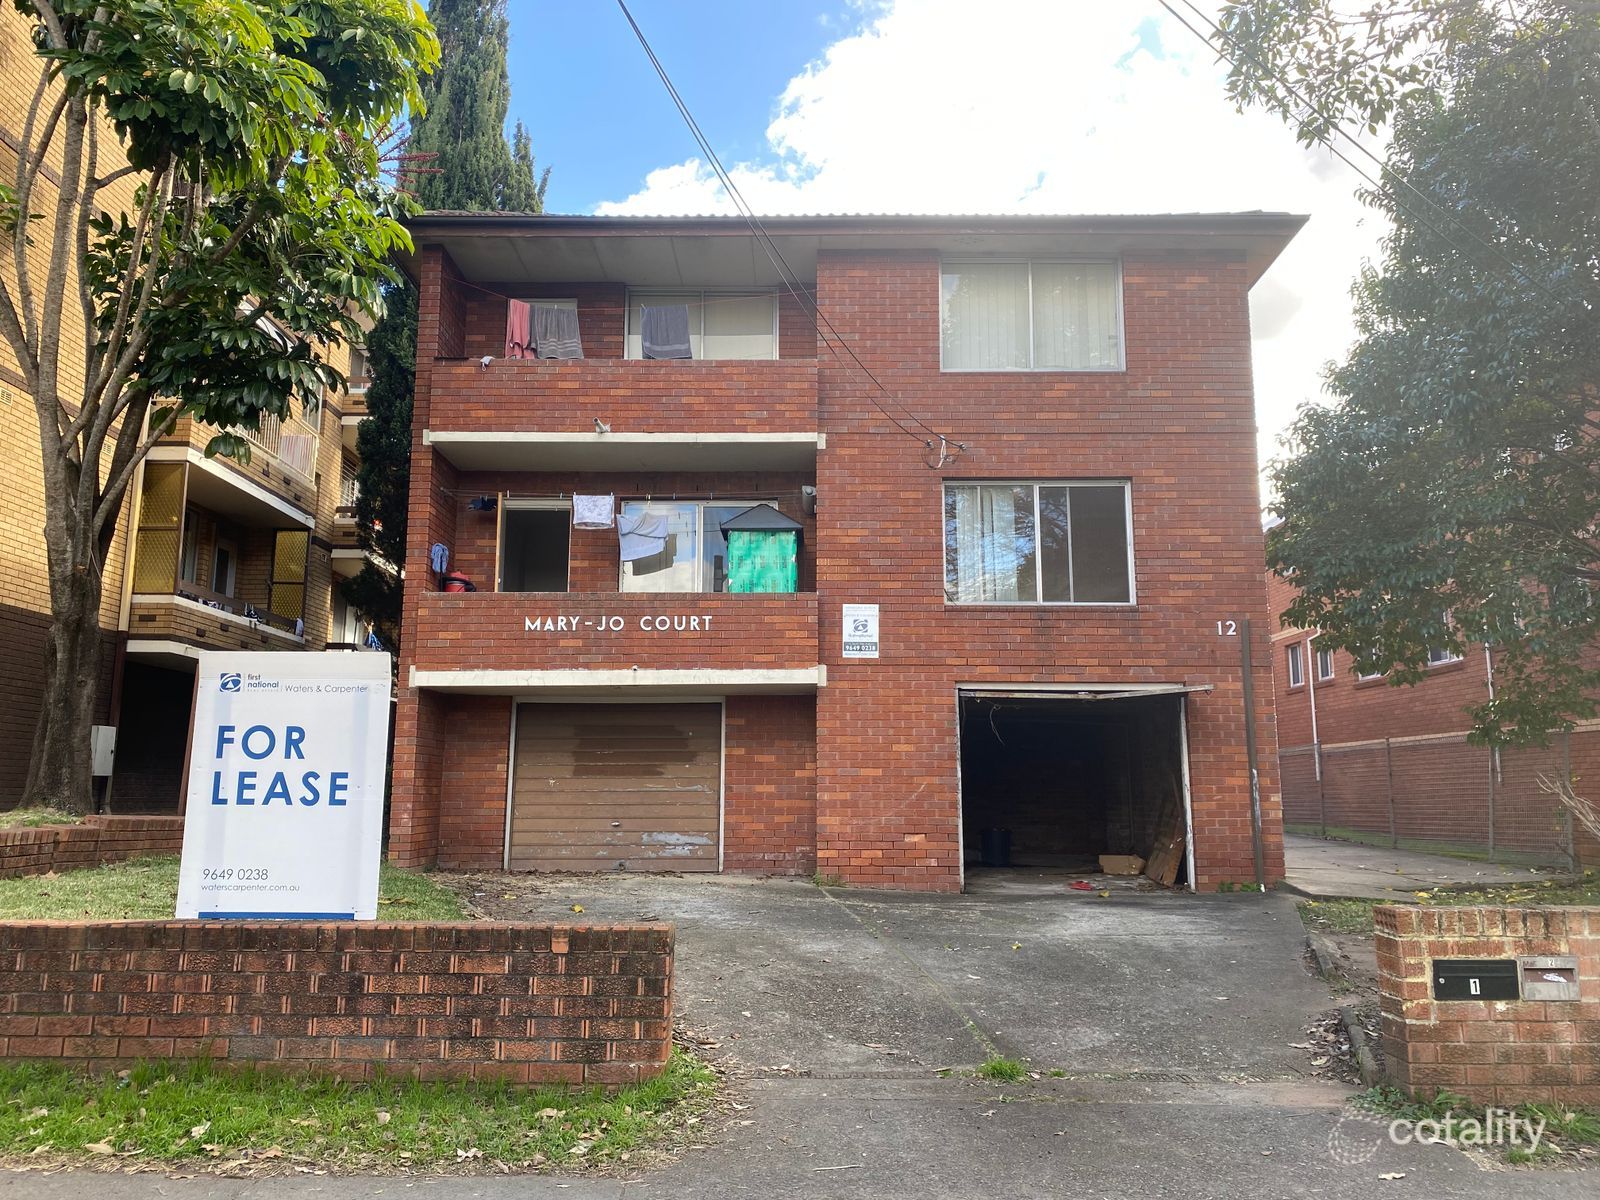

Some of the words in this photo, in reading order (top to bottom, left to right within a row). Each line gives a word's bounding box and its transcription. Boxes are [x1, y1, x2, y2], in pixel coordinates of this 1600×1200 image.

[525, 616, 624, 631] MARY-JO
[640, 616, 713, 631] COURT
[1216, 620, 1237, 636] 12
[247, 673, 261, 681] first
[285, 685, 314, 693] Waters
[315, 685, 322, 693] &
[324, 685, 369, 694] Carpenter
[215, 725, 305, 759] FOR
[211, 771, 349, 806] LEASE
[202, 868, 234, 881] 9649
[237, 868, 269, 881] 0238
[200, 883, 300, 893] waterscarpenter.com.au
[1471, 980, 1479, 994] 1
